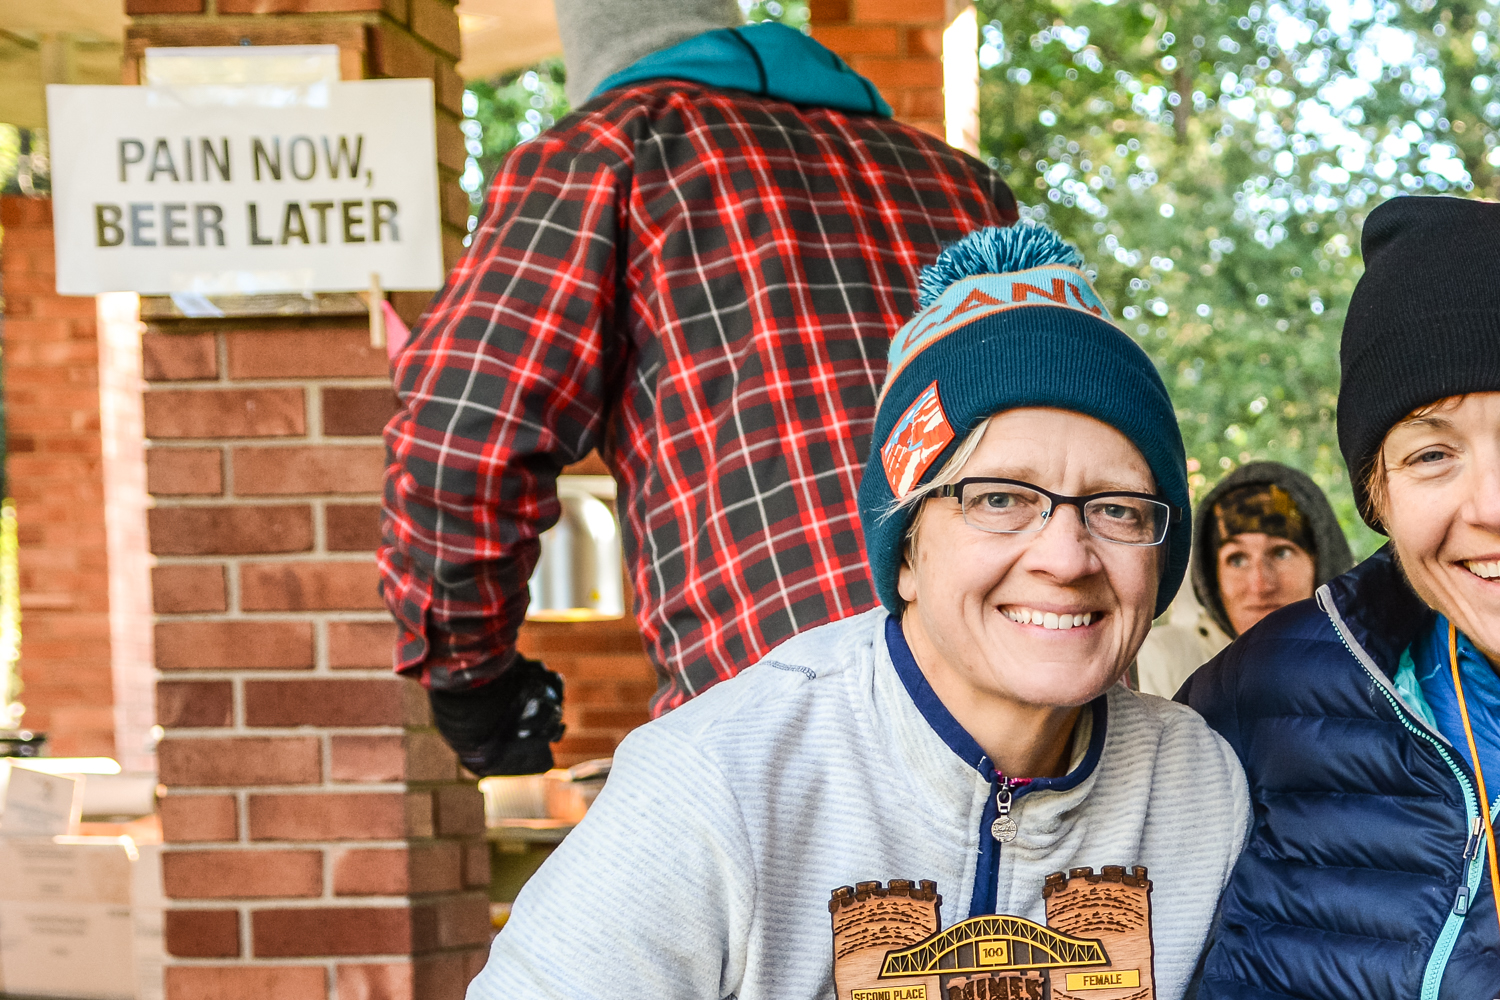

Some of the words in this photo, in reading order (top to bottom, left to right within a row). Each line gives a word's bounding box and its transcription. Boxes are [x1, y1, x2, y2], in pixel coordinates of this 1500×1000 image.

[118, 136, 231, 182] PAIN
[252, 133, 373, 188] NOW,
[94, 203, 226, 247] BEER
[249, 198, 401, 245] LATER
[982, 947, 1004, 958] 100
[1082, 973, 1122, 986] FEMALE
[893, 988, 925, 1000] PLACE
